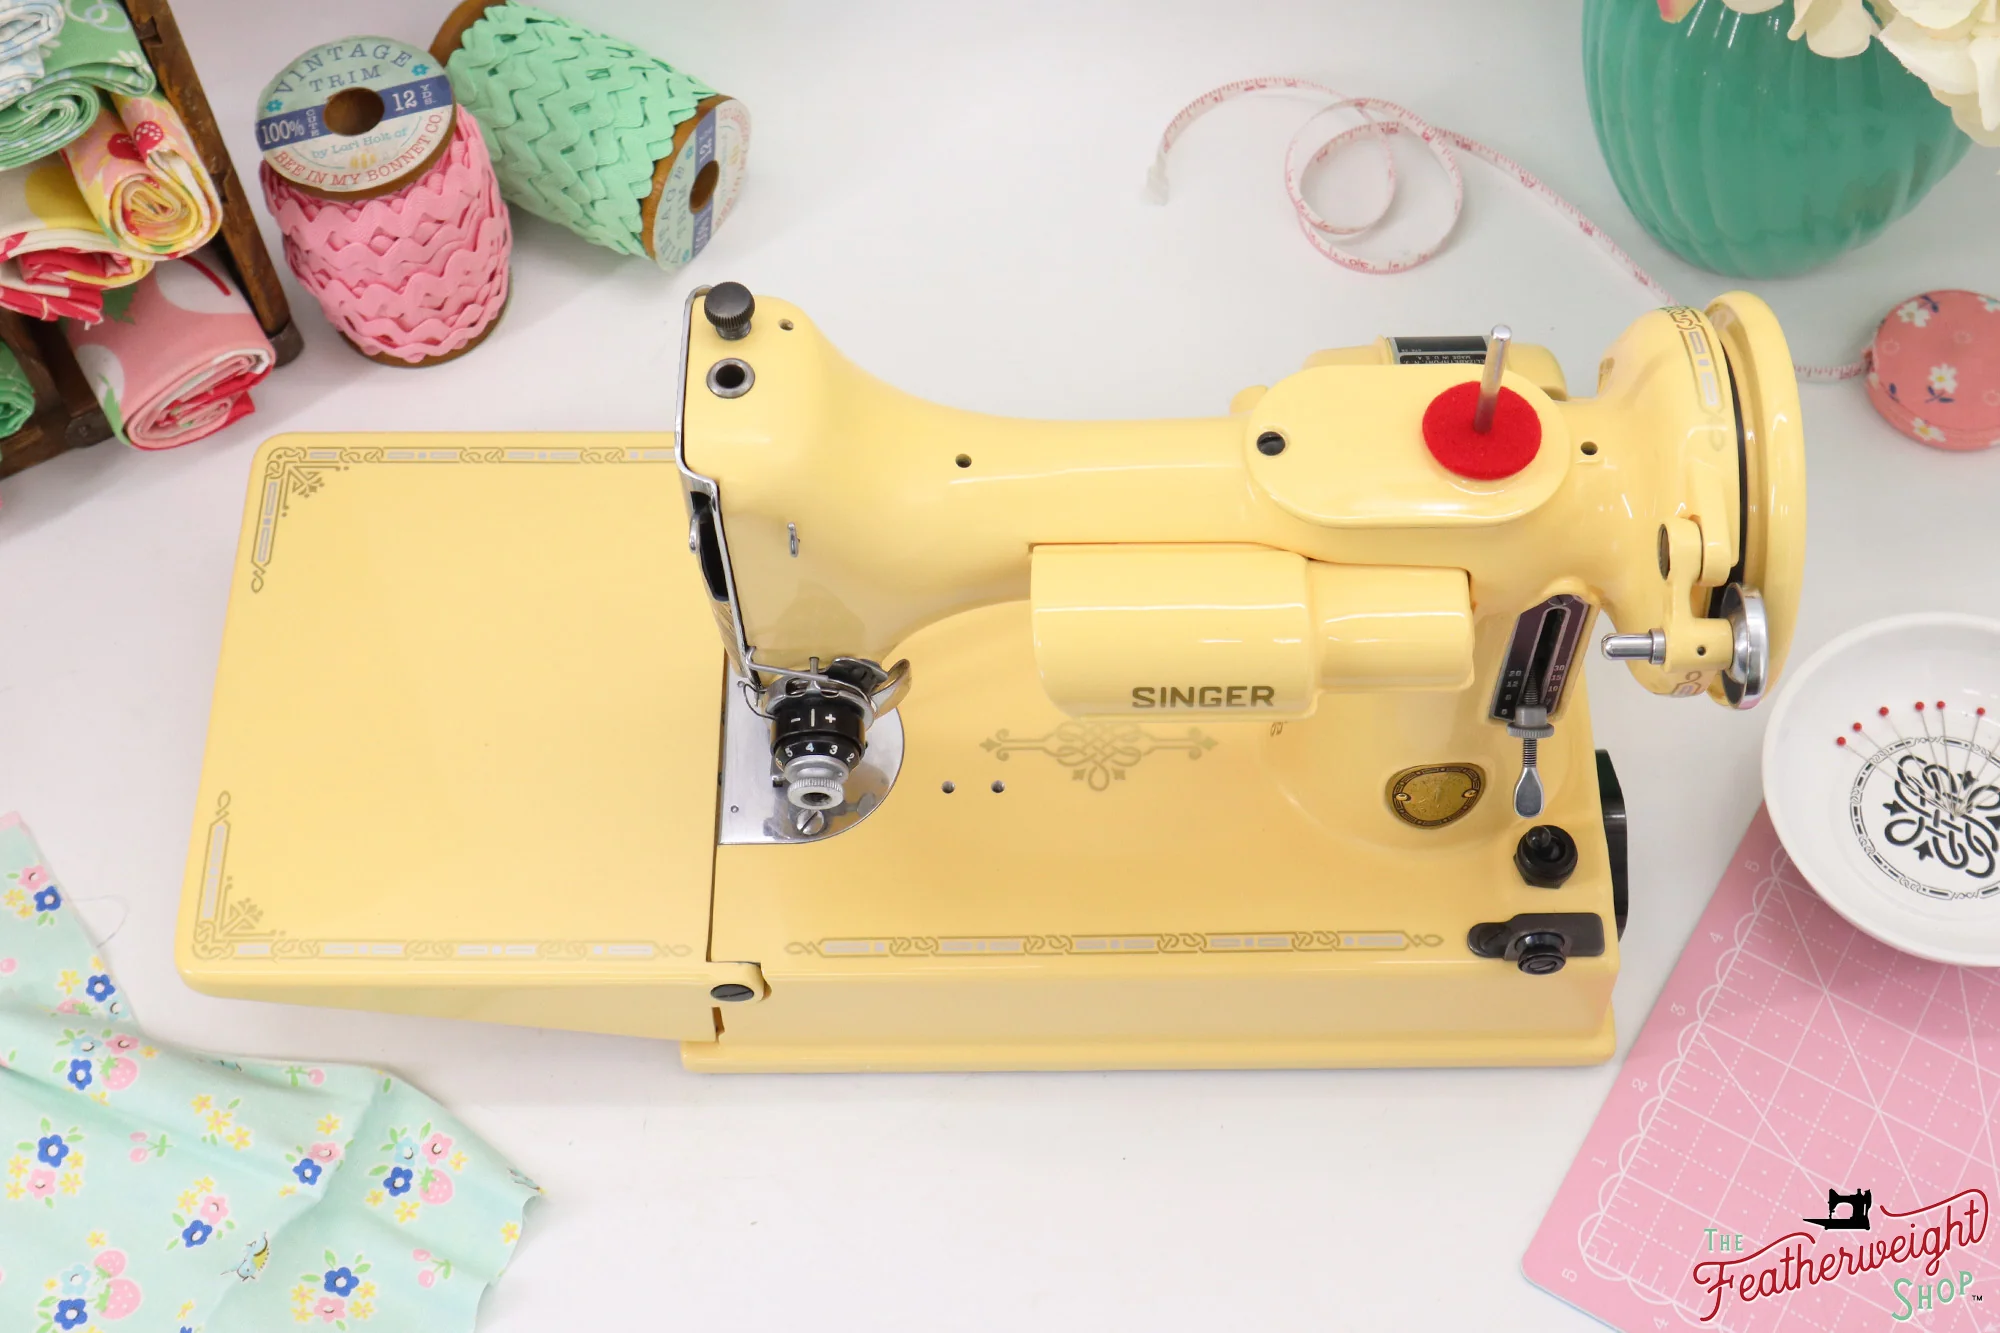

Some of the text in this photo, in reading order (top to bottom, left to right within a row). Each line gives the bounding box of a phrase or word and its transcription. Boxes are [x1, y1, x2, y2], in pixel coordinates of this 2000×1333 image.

[273, 43, 412, 94] VINTAGE
[309, 64, 381, 93] TRIM
[391, 89, 418, 112] 12
[261, 119, 305, 144] 100%
[273, 150, 306, 177] BEE
[305, 169, 329, 185] IN
[331, 173, 361, 186] MY
[367, 134, 432, 182] BONNET
[1132, 685, 1275, 708] SINGER
[785, 747, 793, 757] 5
[805, 742, 814, 753] 4
[829, 744, 838, 755] 3
[846, 753, 854, 763] 2
[1710, 931, 1723, 943] 4
[1670, 1003, 1685, 1017] 3
[1631, 1077, 1648, 1092] 2
[1592, 1156, 1607, 1168] 1
[1561, 1267, 1578, 1283] 5
[1653, 1316, 1669, 1331] 4
